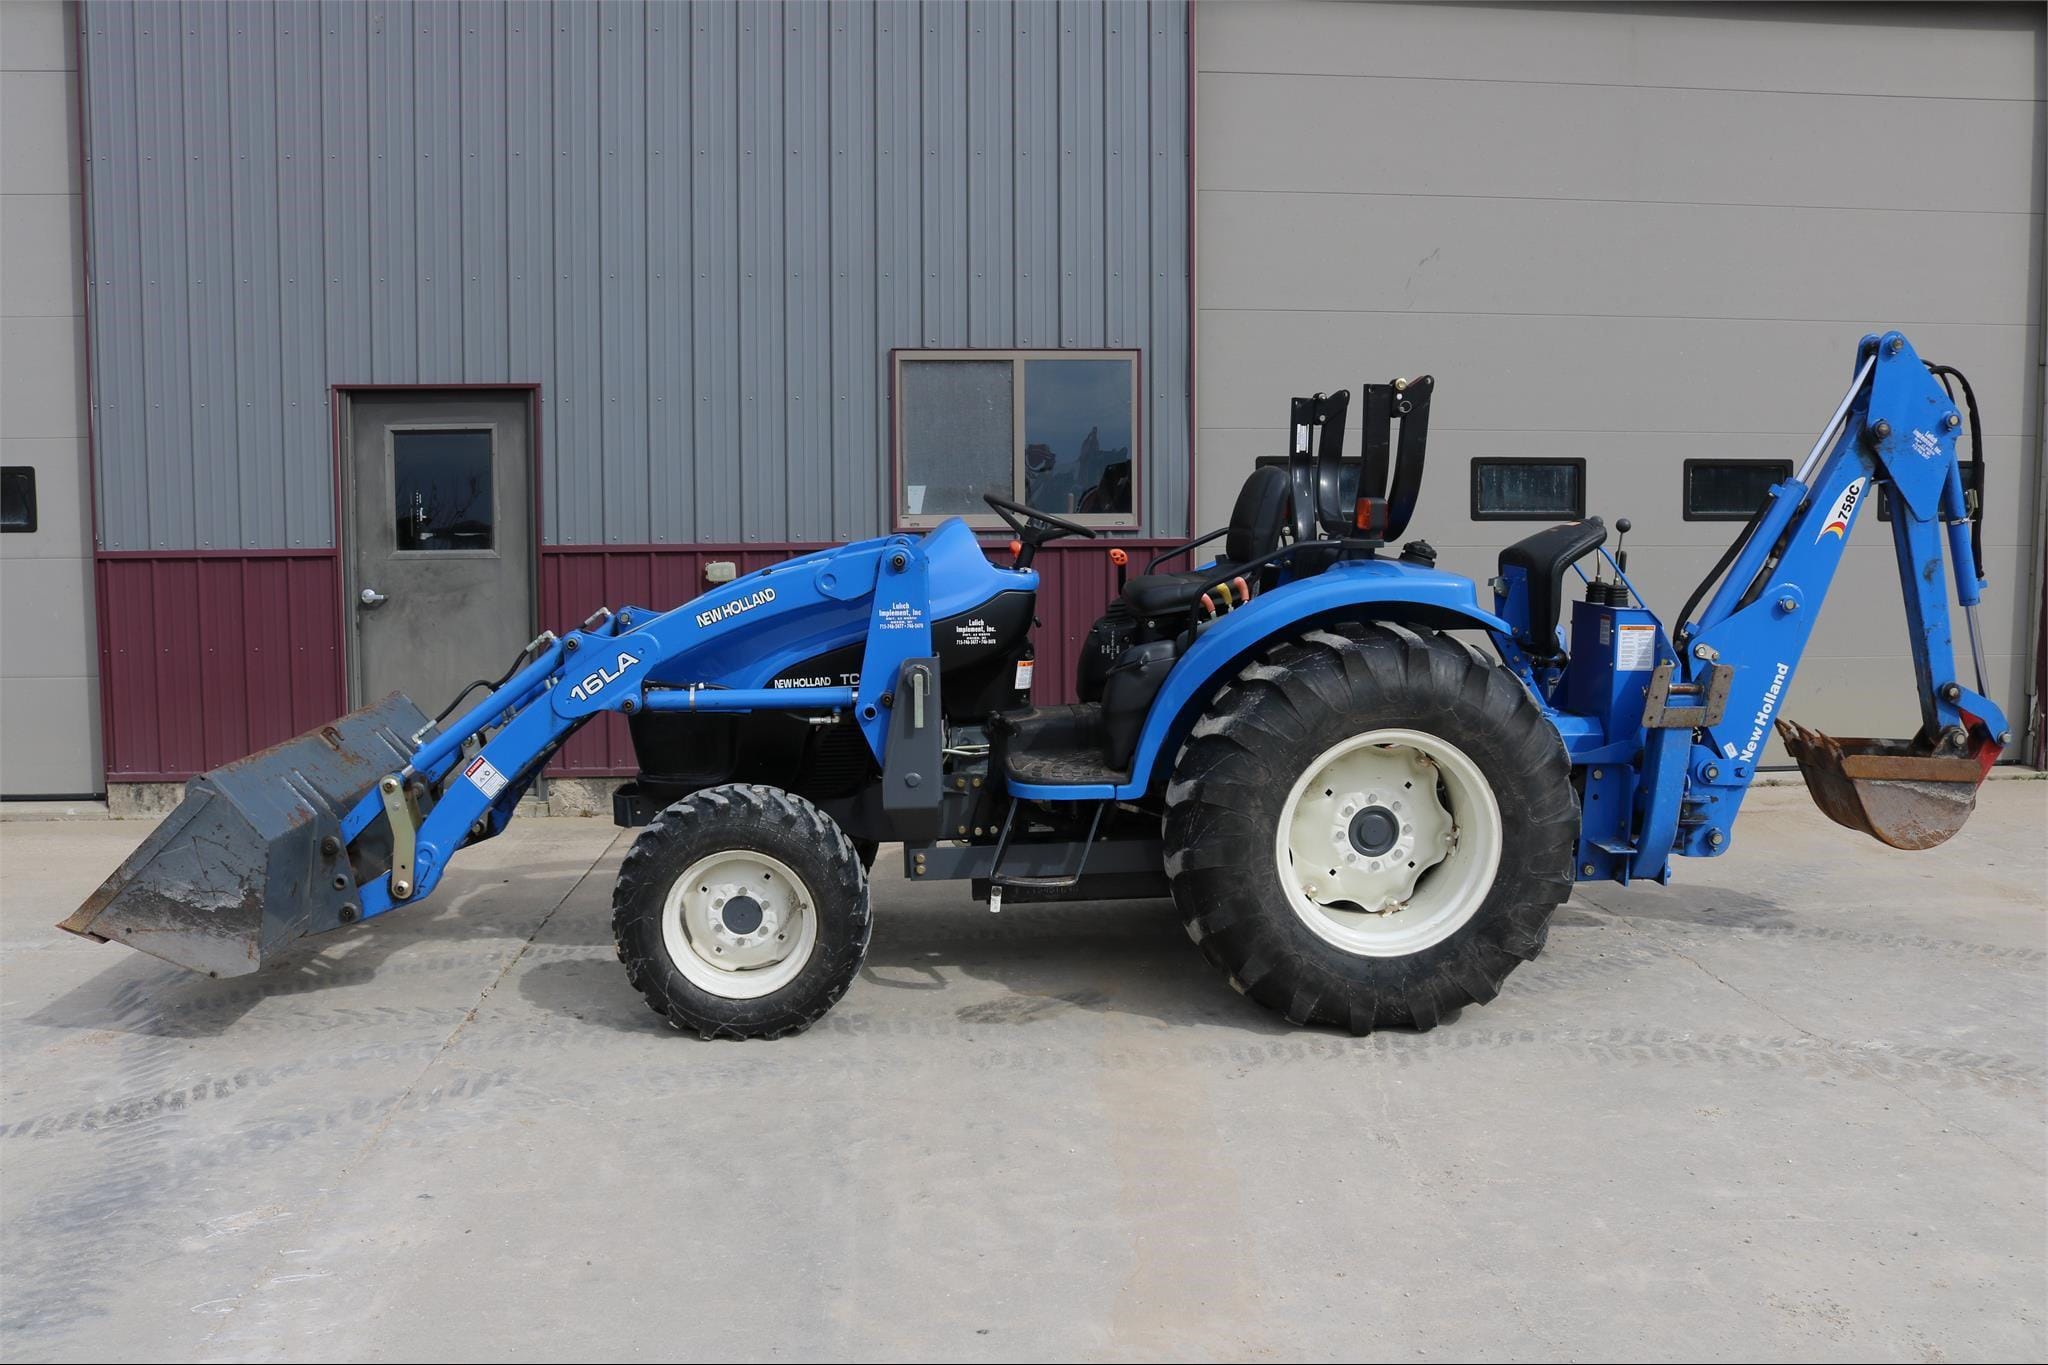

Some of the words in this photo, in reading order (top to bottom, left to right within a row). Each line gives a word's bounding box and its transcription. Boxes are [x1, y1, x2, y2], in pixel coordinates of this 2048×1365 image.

[1838, 484, 1860, 520] 758C
[695, 609, 722, 628] NEW
[721, 587, 776, 620] HOLLAND
[569, 651, 640, 703] 16LA
[774, 679, 792, 689] NEW
[793, 677, 832, 688] HOLLAND
[840, 673, 860, 685] TC
[1739, 727, 1763, 763] New
[1754, 662, 1789, 727] Holland
